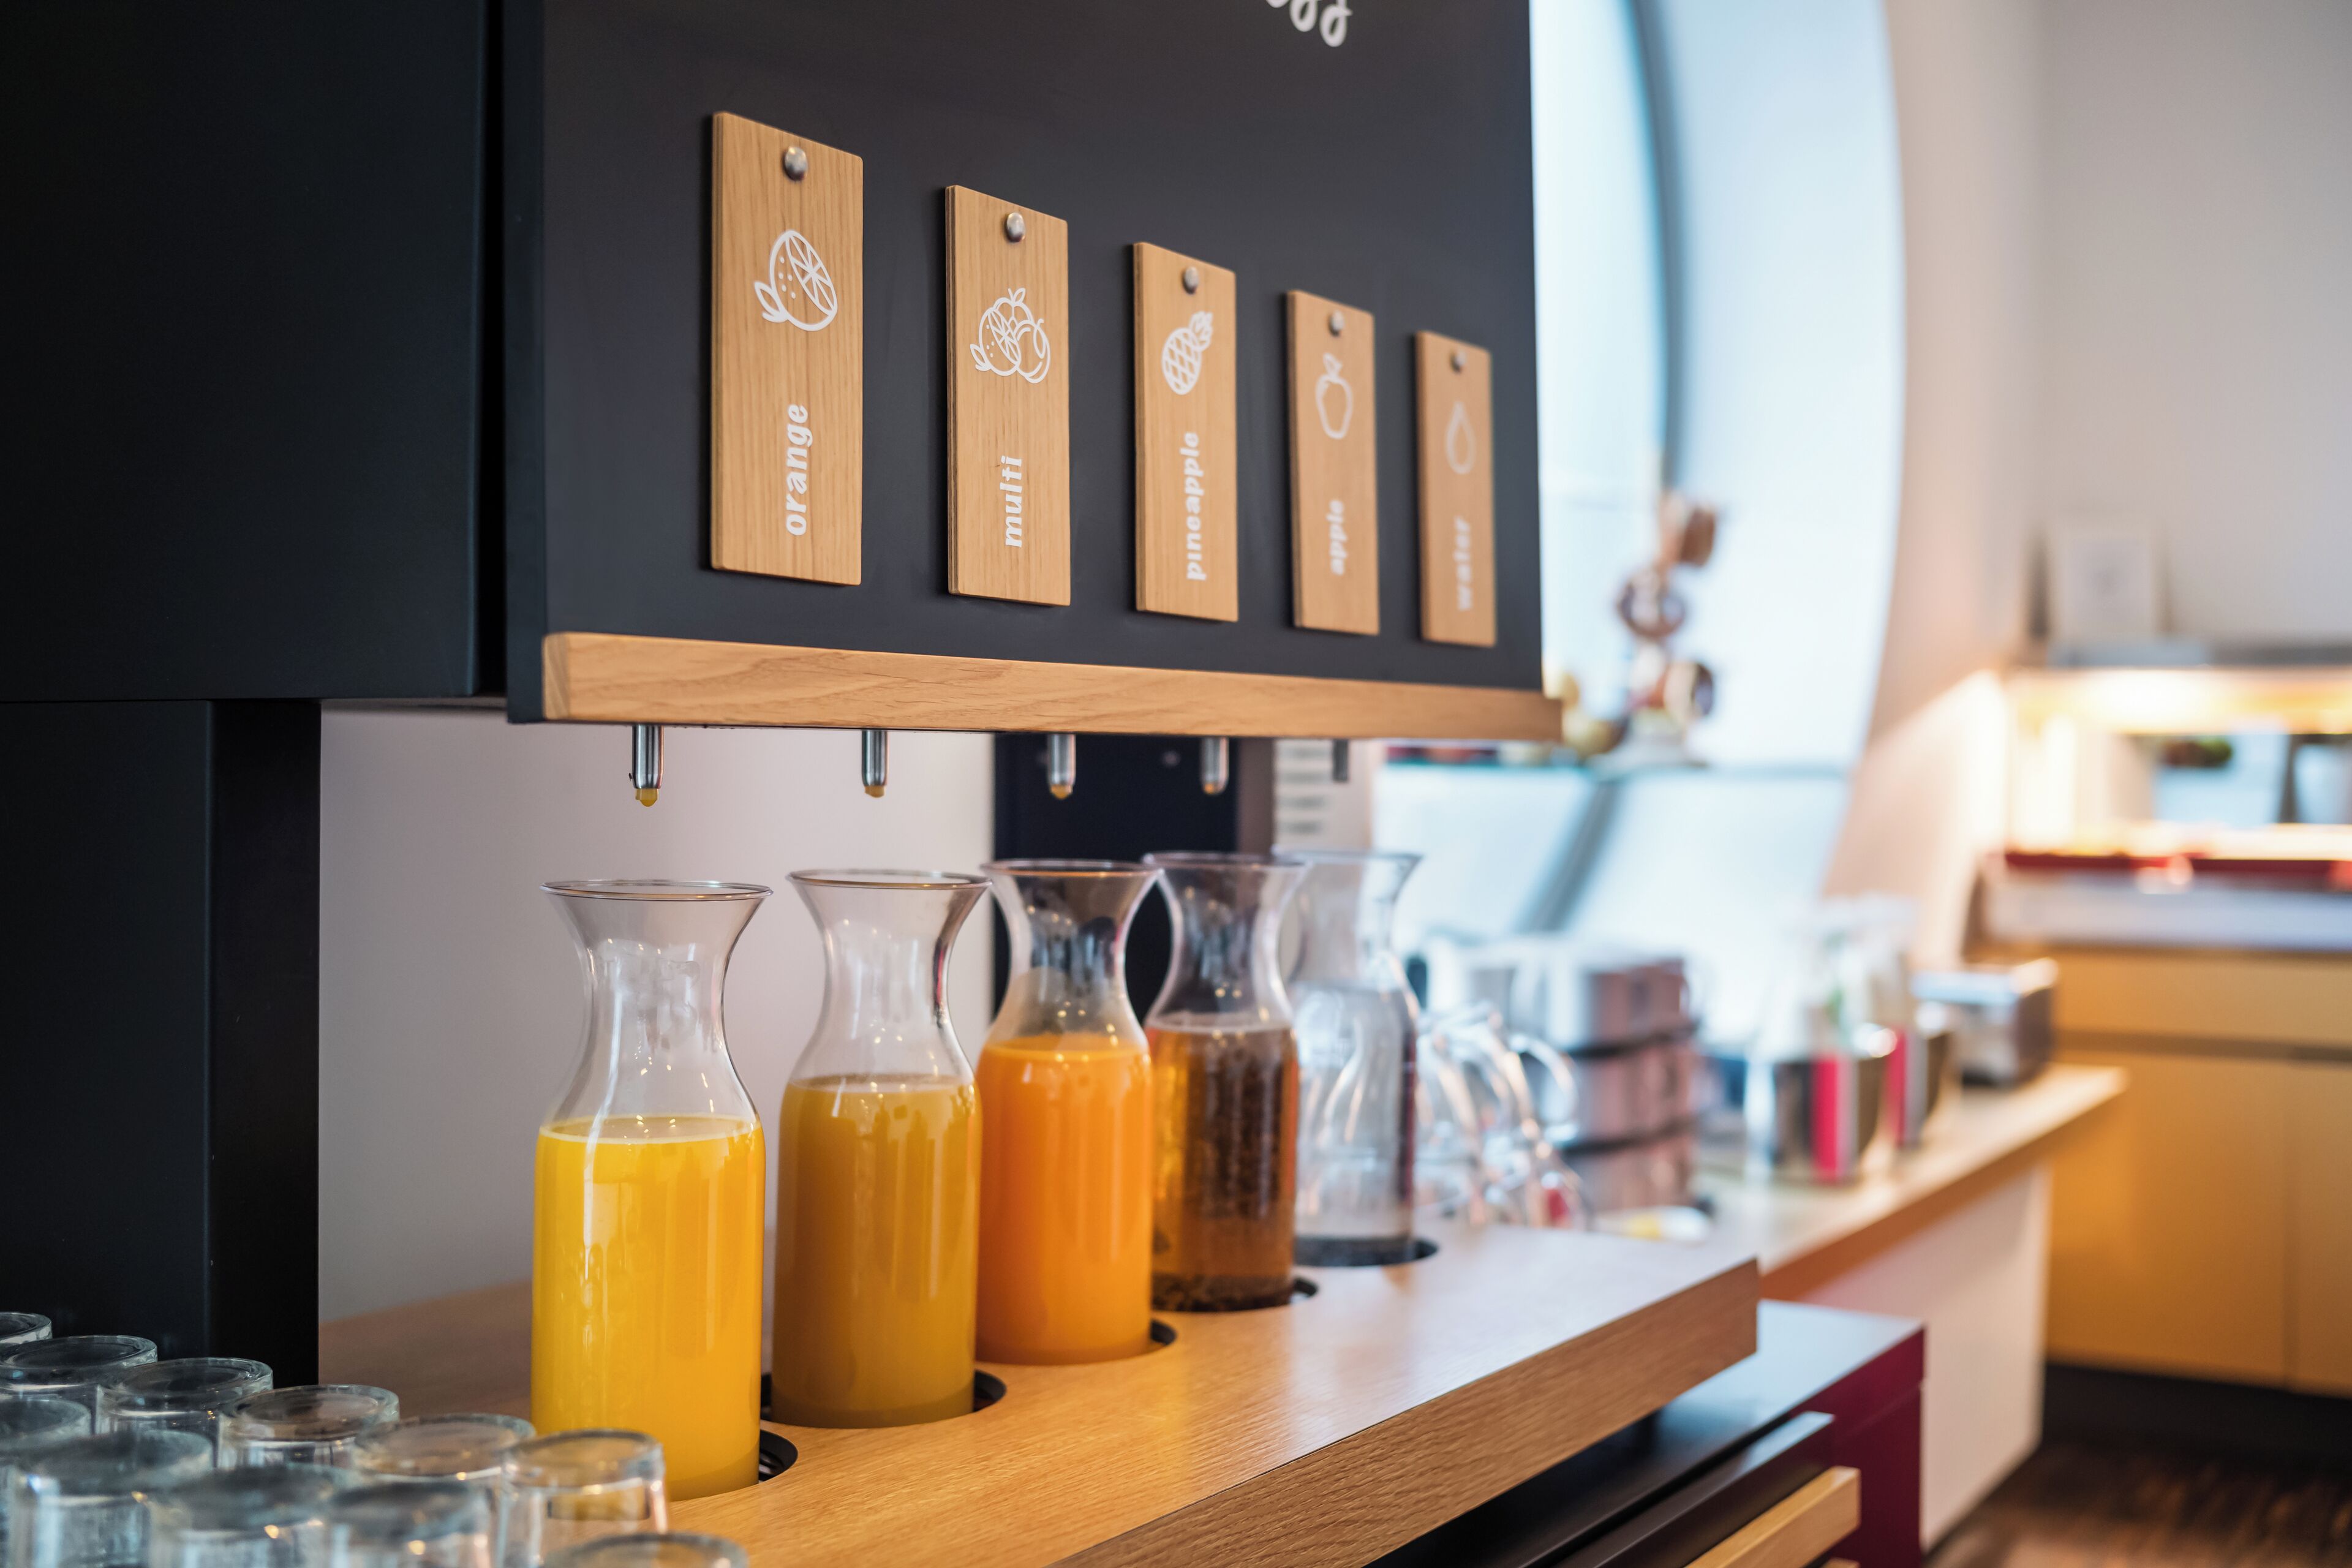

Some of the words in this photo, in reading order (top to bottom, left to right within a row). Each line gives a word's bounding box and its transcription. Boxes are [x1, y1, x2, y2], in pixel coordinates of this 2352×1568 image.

[785, 404, 813, 536] orange
[999, 455, 1023, 548] multi
[1179, 431, 1207, 581] pineapple
[1325, 499, 1348, 576] apple
